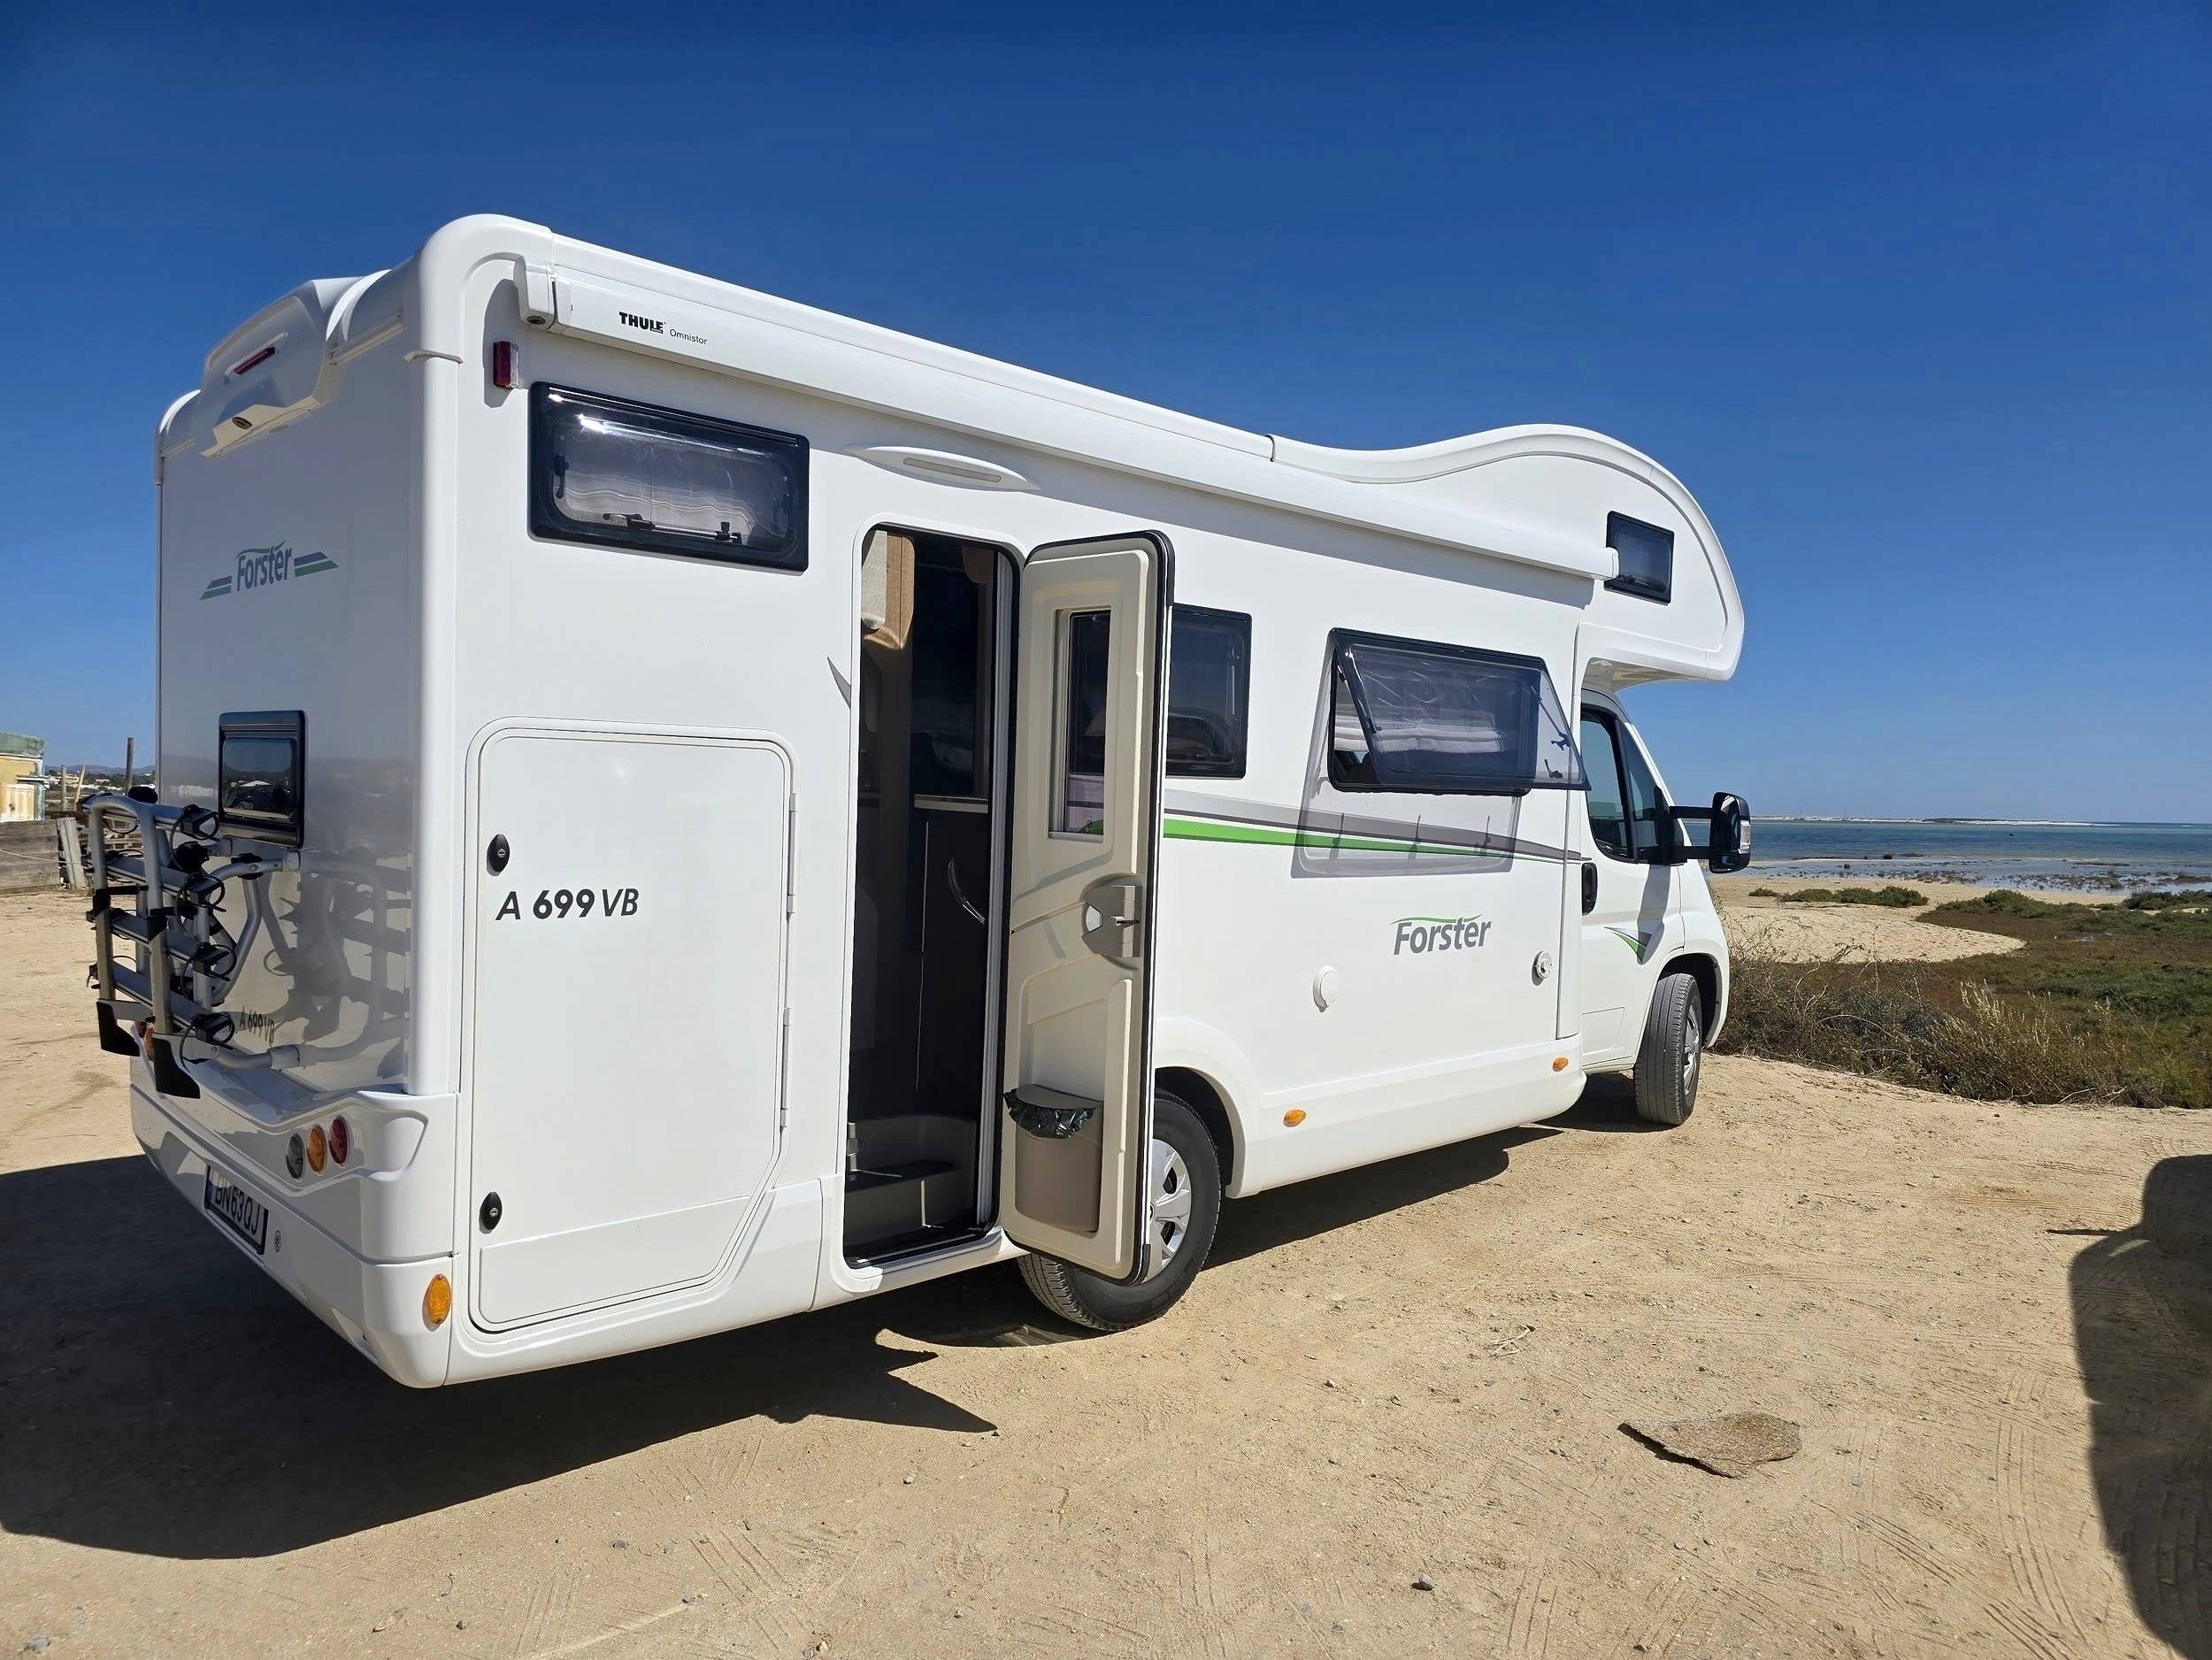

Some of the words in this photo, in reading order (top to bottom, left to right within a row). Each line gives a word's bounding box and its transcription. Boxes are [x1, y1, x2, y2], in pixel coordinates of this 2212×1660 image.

[619, 311, 664, 334] THULE
[670, 328, 708, 344] Omnistor
[236, 545, 292, 591] Forster
[495, 891, 521, 920] A
[533, 888, 595, 919] 699
[602, 888, 639, 917] VB
[1394, 917, 1492, 955] Forster
[239, 1005, 246, 1031] A
[248, 1009, 263, 1038] 699
[263, 1016, 274, 1044] VB
